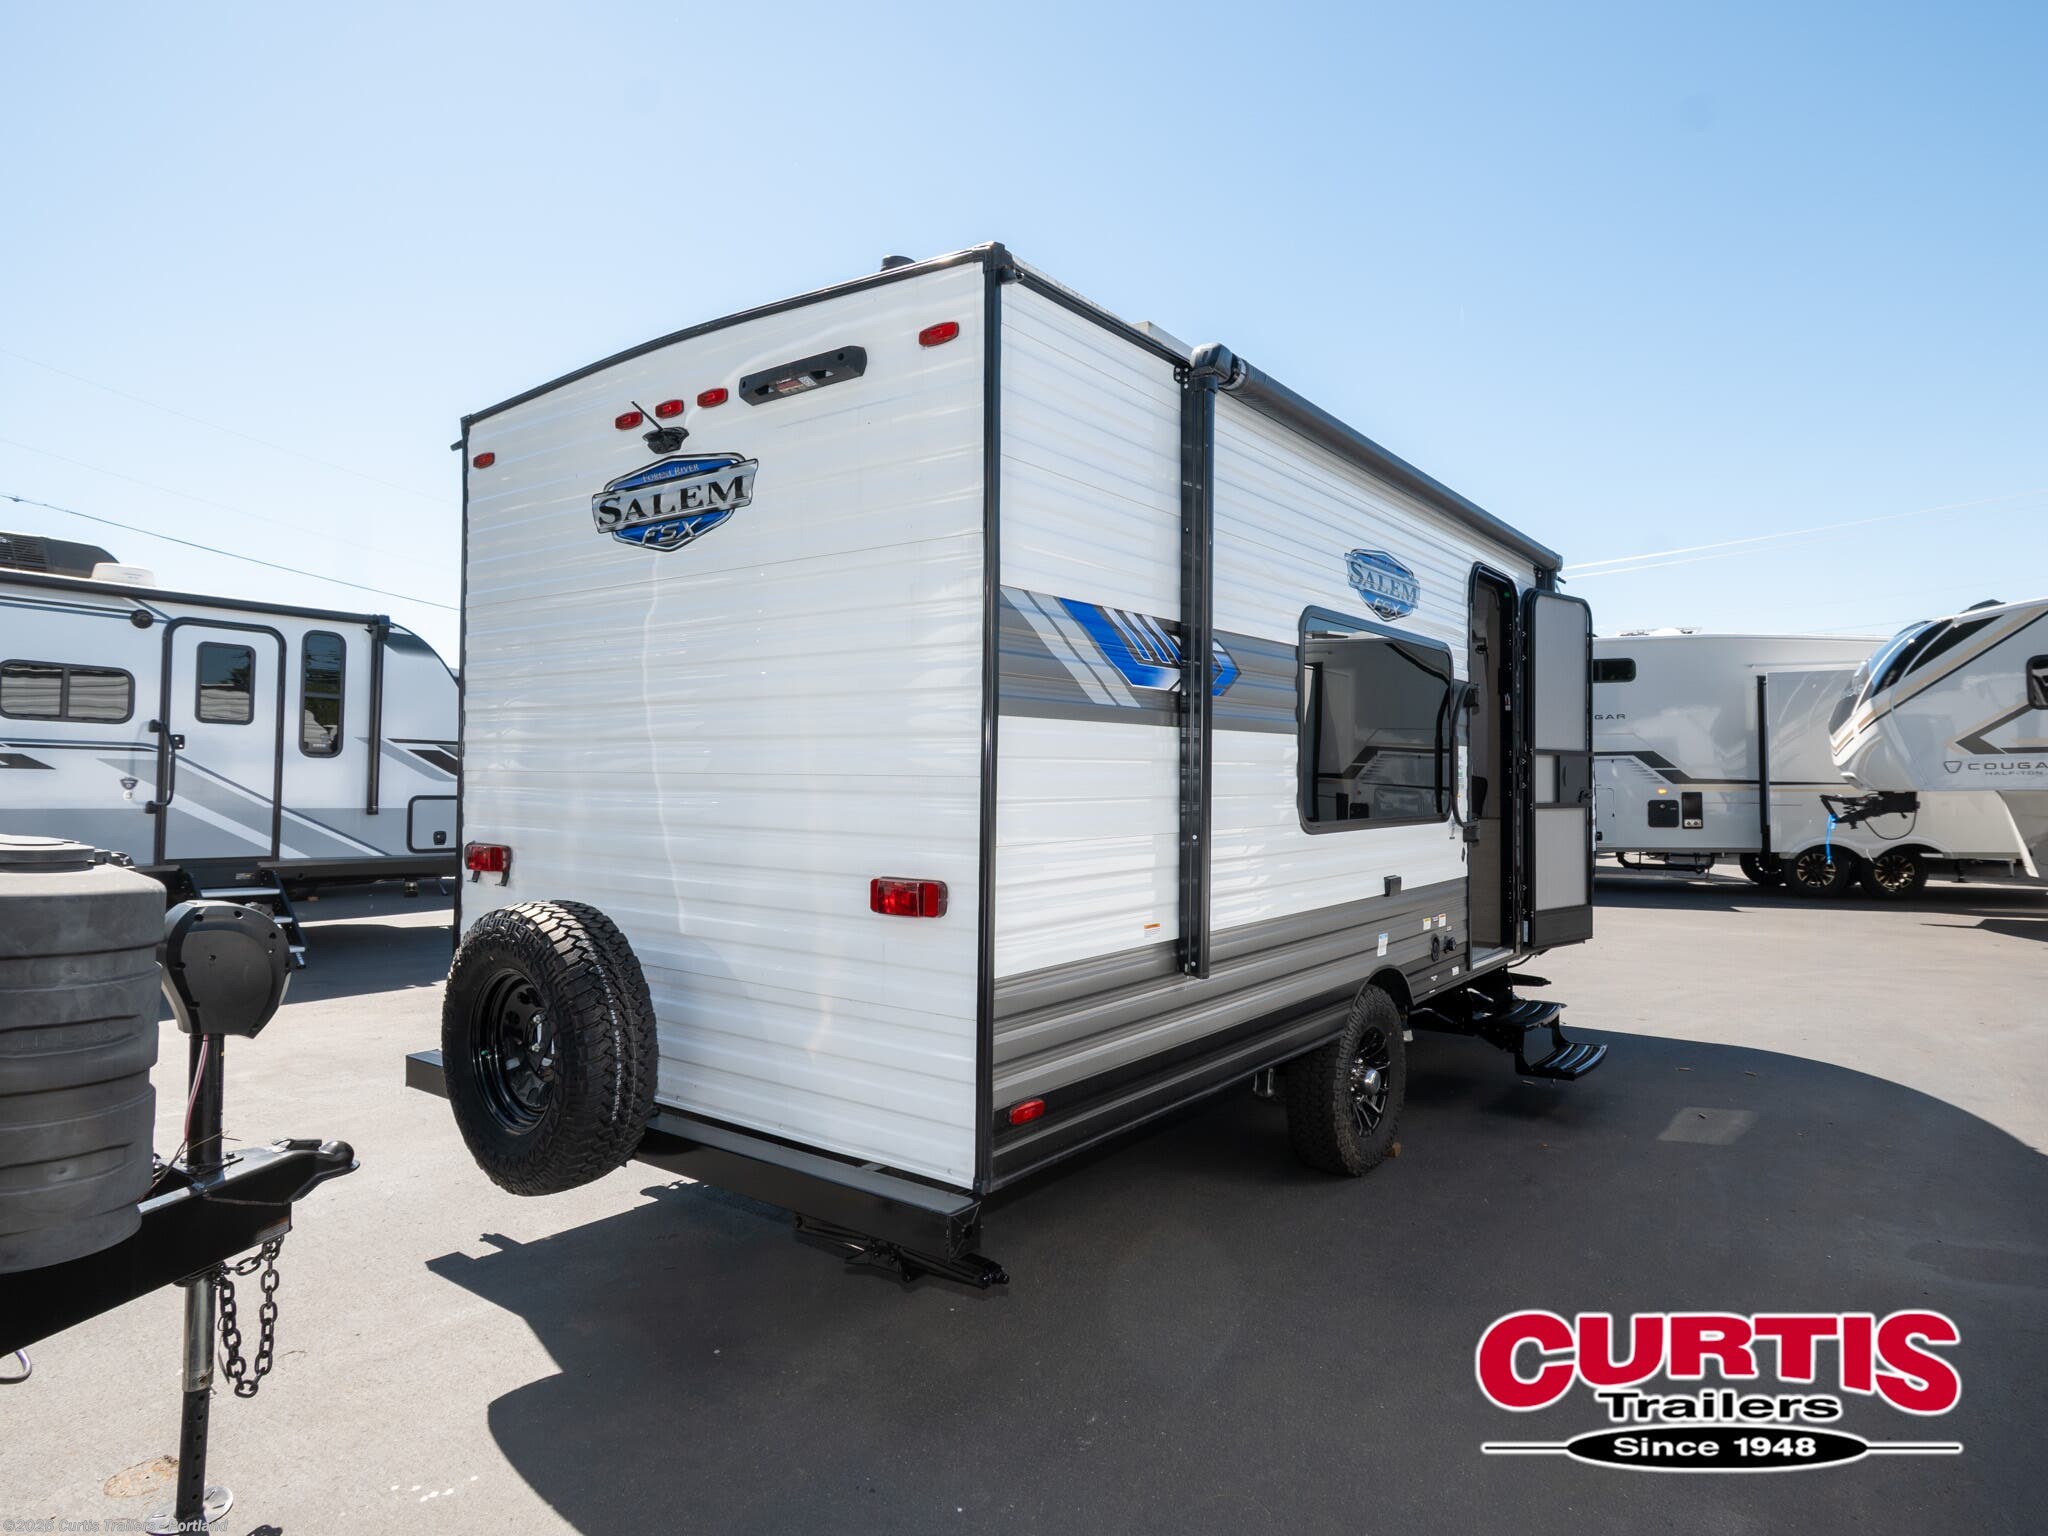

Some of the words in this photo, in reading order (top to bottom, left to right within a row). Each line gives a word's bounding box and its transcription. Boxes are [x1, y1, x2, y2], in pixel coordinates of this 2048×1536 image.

[674, 463, 700, 476] RIVER
[598, 474, 752, 526] SALEM
[641, 517, 703, 545] FSX
[1349, 560, 1418, 603] SALEM
[1967, 762, 2048, 770] COUGA
